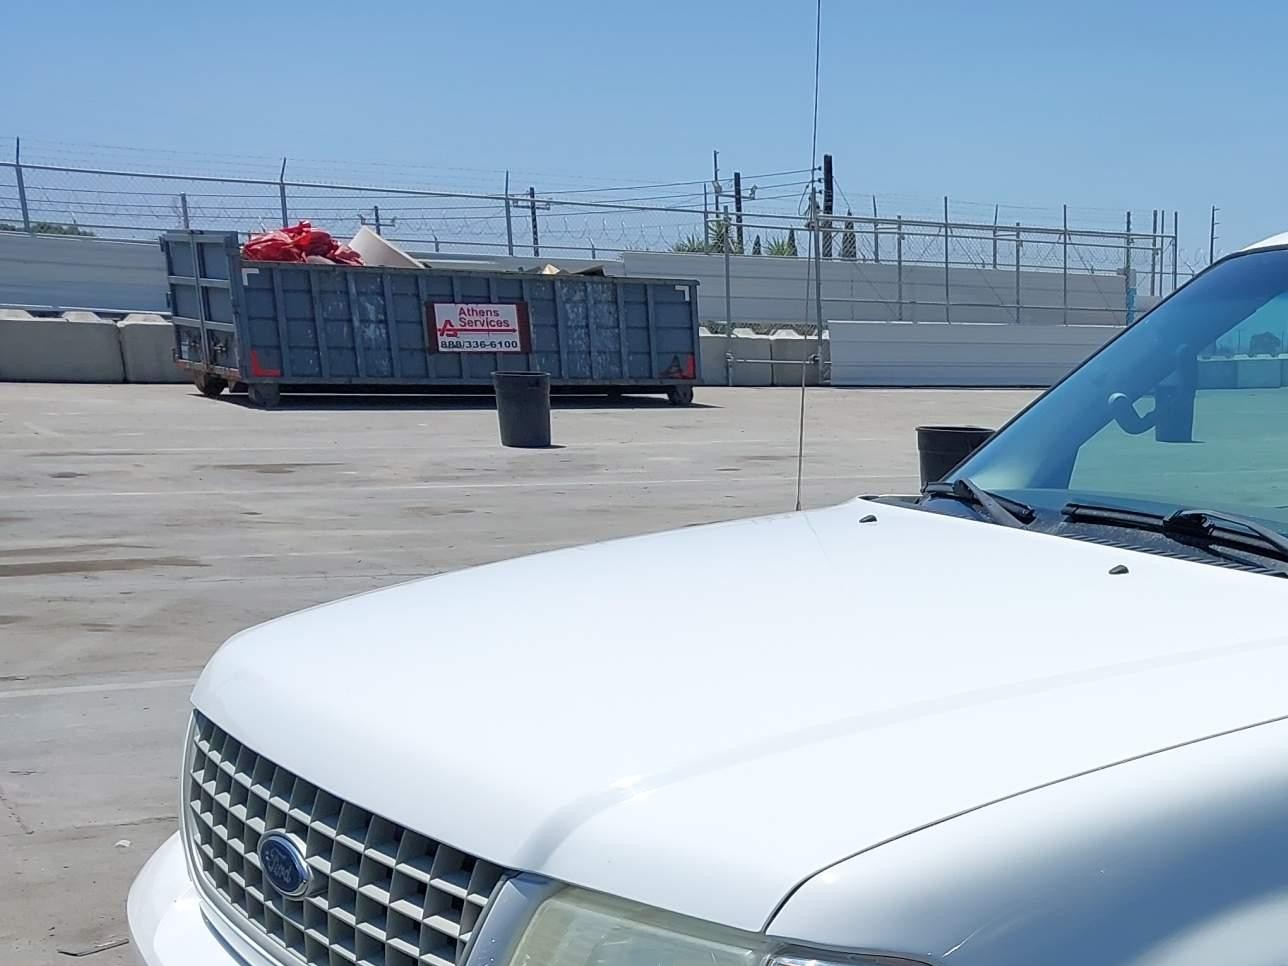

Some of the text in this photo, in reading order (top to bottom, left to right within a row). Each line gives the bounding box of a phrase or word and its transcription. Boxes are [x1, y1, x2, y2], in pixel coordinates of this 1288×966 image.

[458, 307, 499, 317] Athens
[458, 317, 510, 328] Services
[440, 340, 518, 349] 888/336-6100
